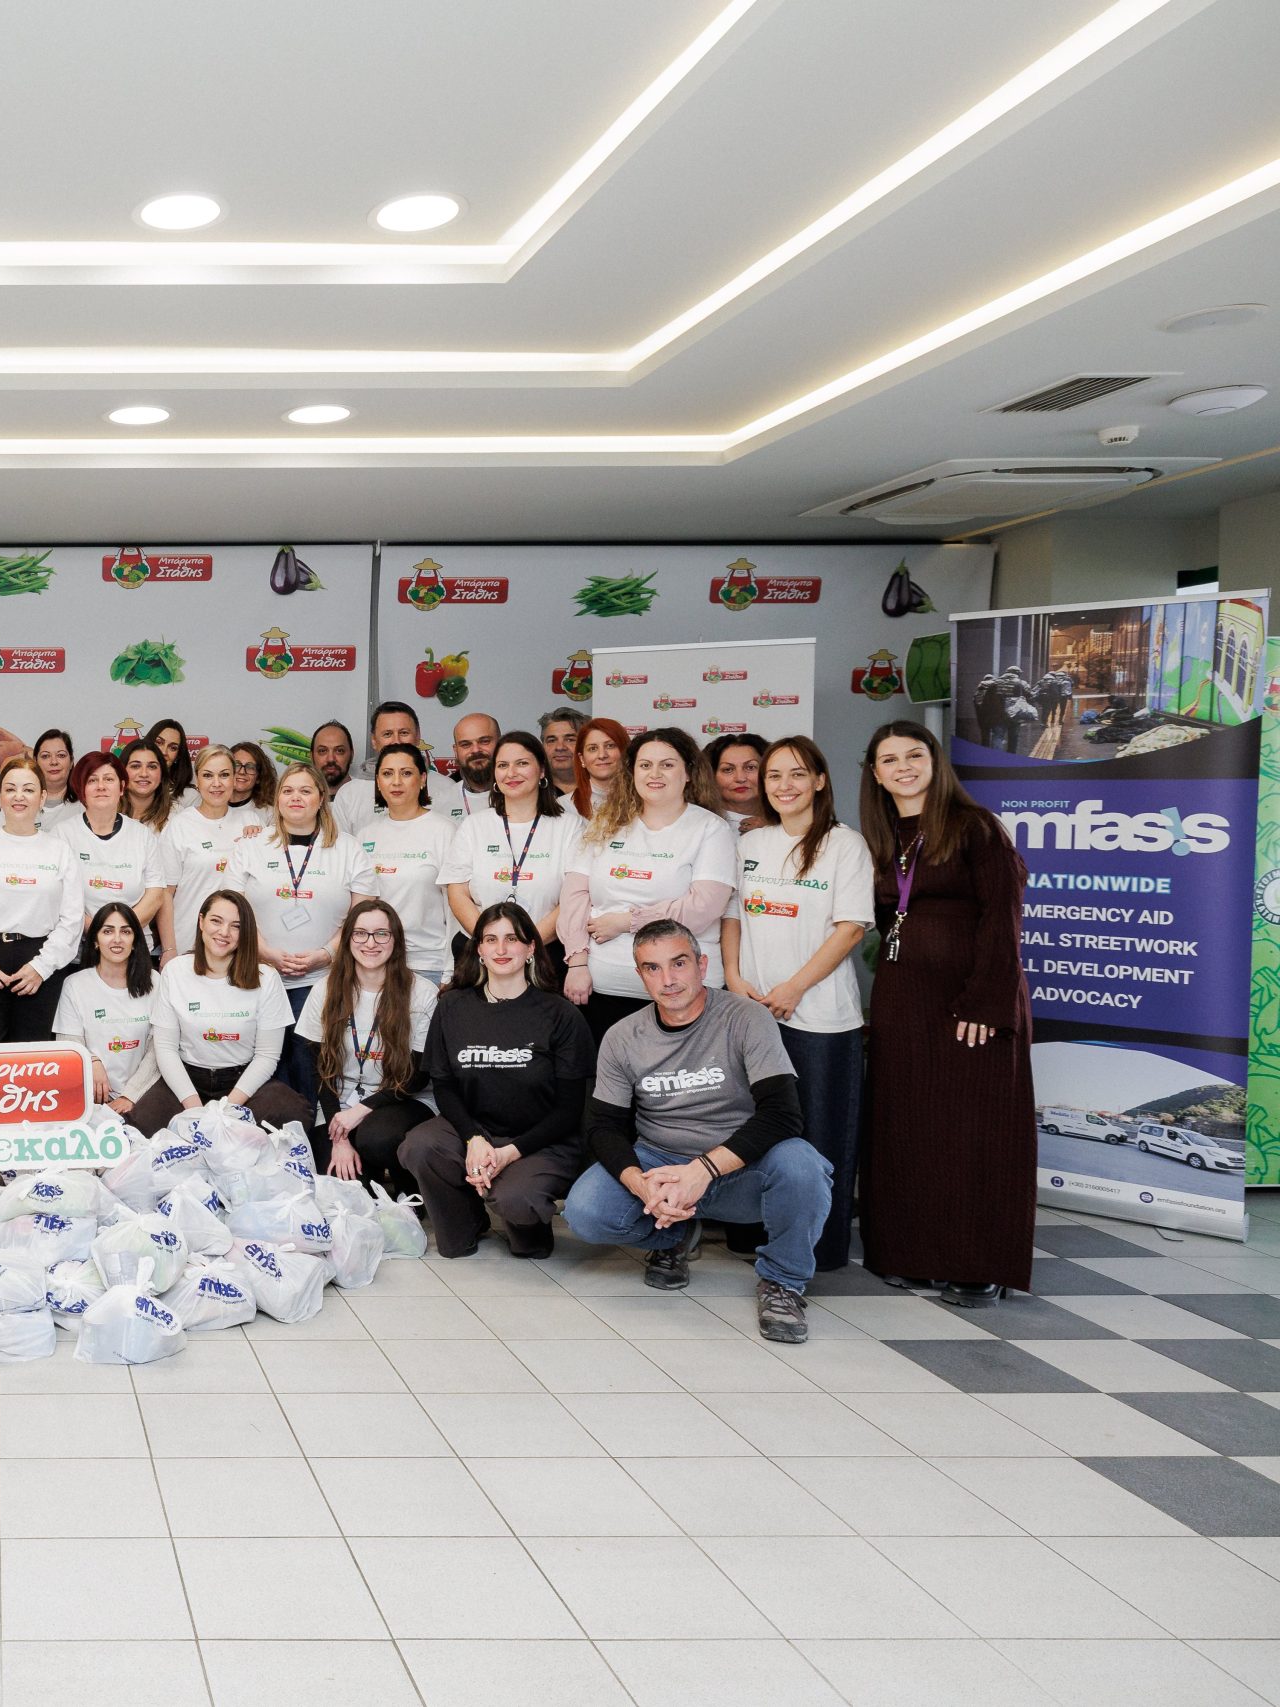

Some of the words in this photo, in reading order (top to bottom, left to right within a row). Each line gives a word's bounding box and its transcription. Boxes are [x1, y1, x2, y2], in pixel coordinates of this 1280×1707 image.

[158, 556, 204, 568] Μπάρμπα
[156, 565, 203, 578] Στάθης
[454, 579, 500, 591] Μπάρμπα
[767, 578, 813, 590] Μπάρμπα
[451, 588, 498, 601] Στάθης
[763, 587, 811, 600] Στάθης
[11, 649, 57, 660] Μπάρμπα
[302, 647, 348, 658] Μπάρμπα
[10, 658, 56, 670] Στάθης
[300, 656, 346, 668] Στάθης
[1001, 800, 1028, 808] NON
[1031, 800, 1070, 809] PROFIT
[1137, 909, 1174, 925] AID
[1059, 932, 1198, 957] STREETWORK
[1043, 959, 1194, 985] DEVELOPMENT
[1031, 986, 1143, 1009] ADVOCACY
